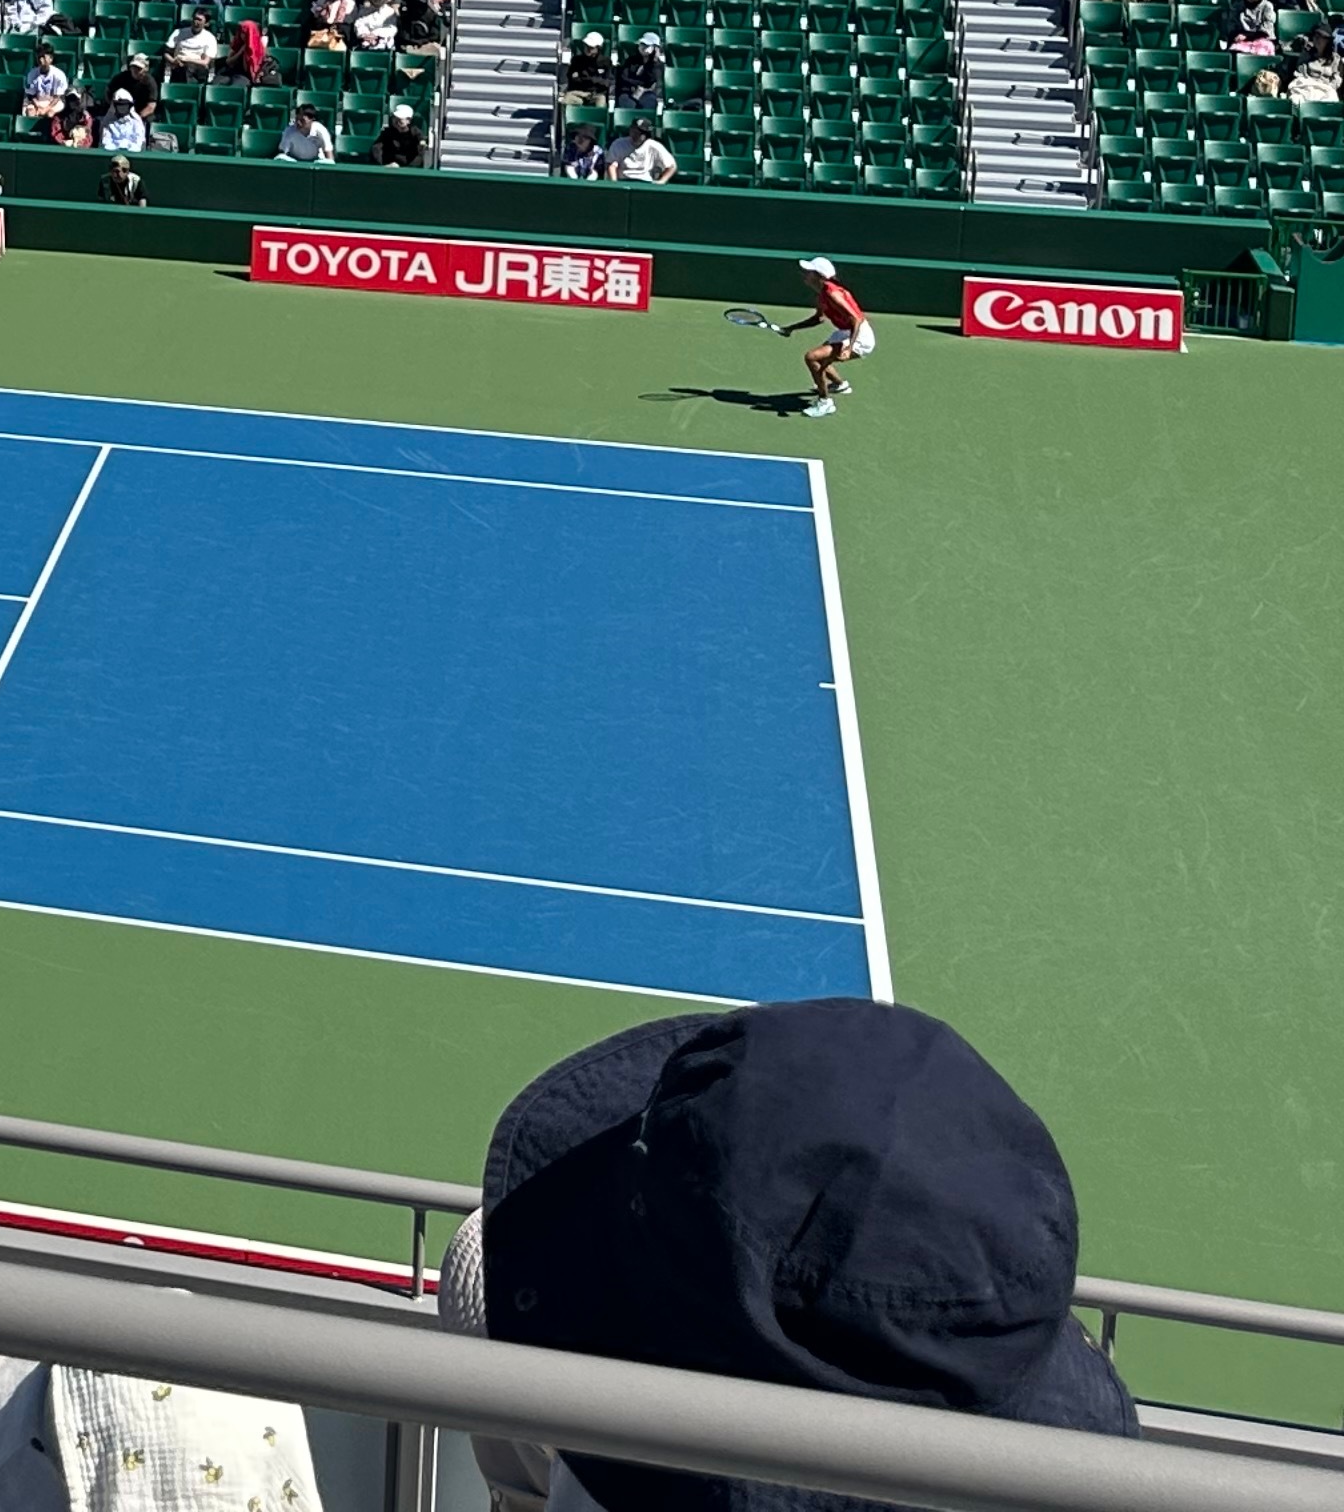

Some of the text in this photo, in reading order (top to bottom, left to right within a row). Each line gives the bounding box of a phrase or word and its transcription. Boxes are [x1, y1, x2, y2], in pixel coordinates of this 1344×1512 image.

[260, 241, 438, 284] TOYOTA
[454, 250, 642, 305] JR東海
[972, 289, 1174, 342] Canon
